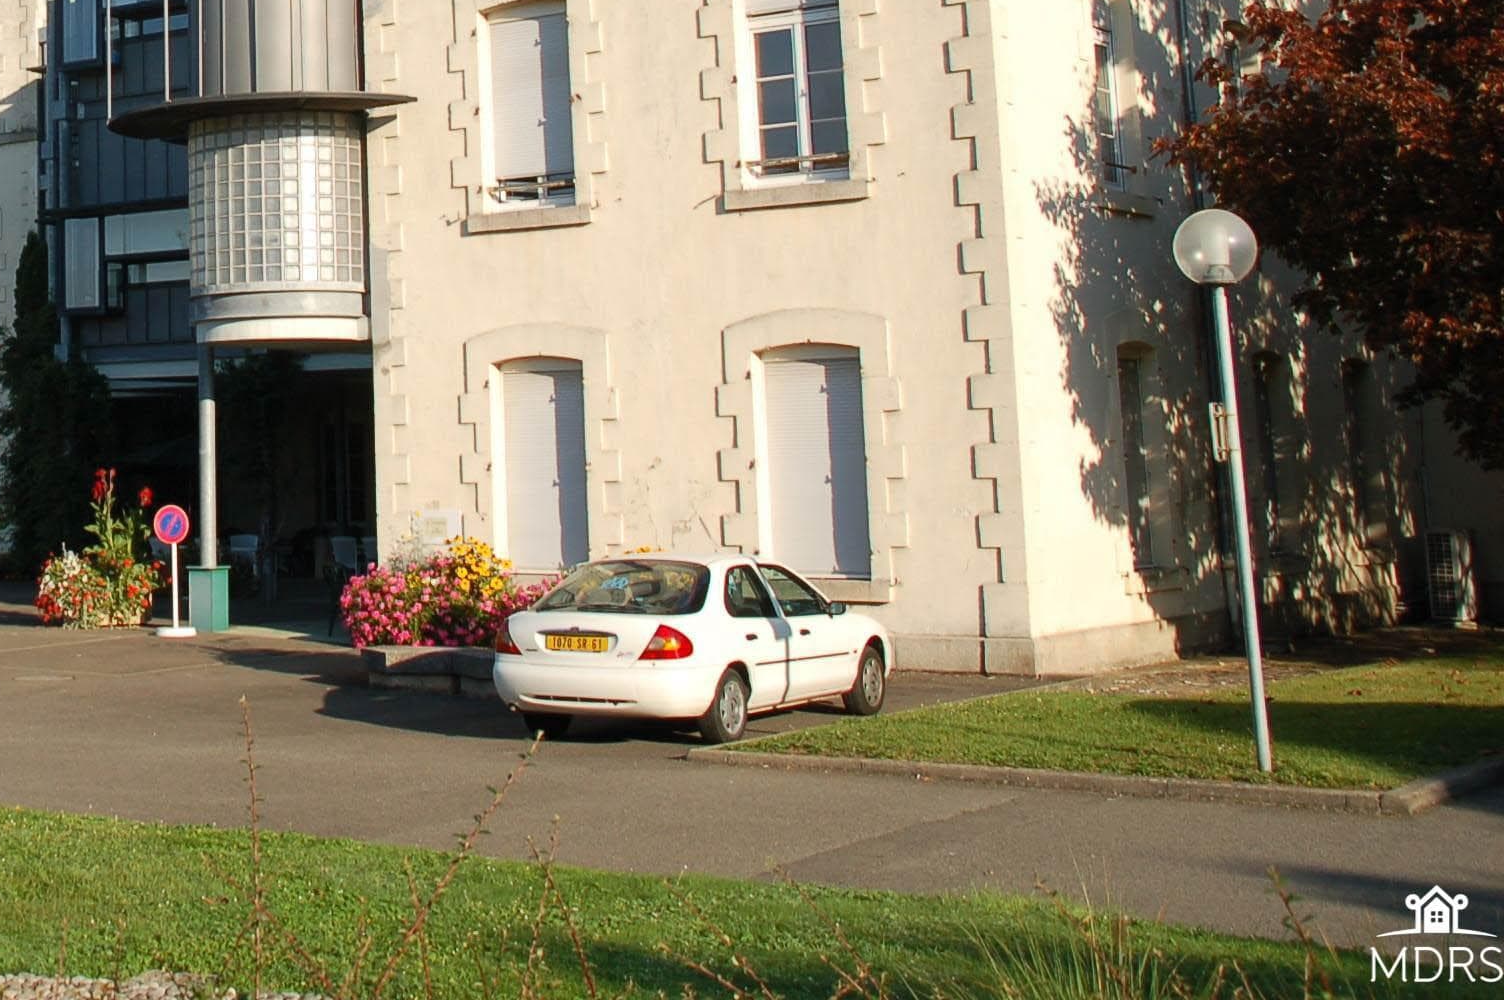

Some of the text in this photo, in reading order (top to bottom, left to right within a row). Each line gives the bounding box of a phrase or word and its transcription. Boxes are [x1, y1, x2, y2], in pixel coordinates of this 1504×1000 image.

[552, 637, 602, 650] 1070 SR 61
